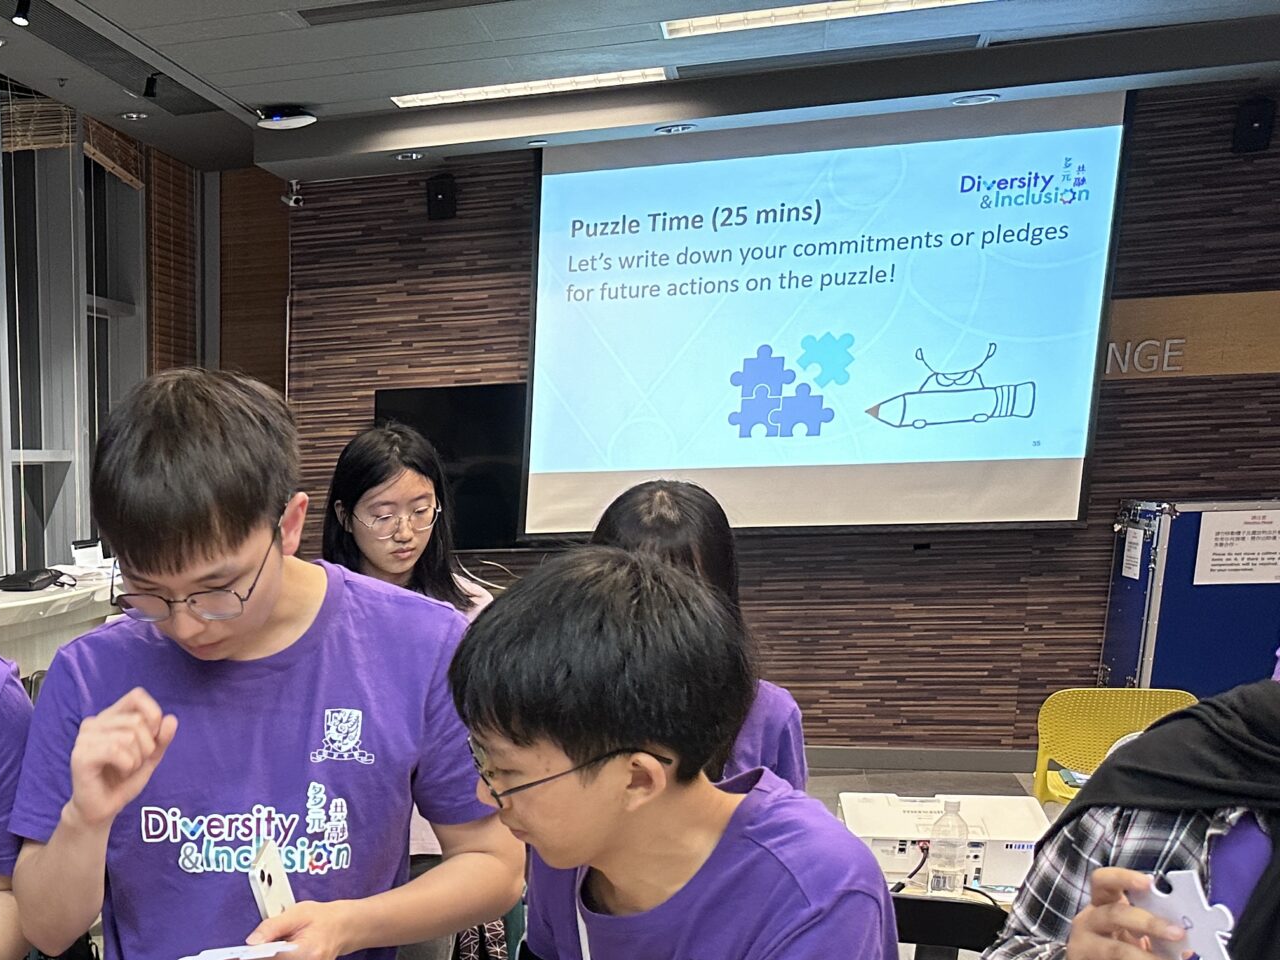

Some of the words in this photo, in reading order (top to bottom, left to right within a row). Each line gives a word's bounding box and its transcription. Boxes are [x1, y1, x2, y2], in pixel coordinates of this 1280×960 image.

[959, 171, 1055, 194] Diversity
[980, 187, 1090, 209] &Inclusion
[570, 214, 641, 238] Puzzle
[647, 211, 704, 232] Time
[711, 206, 749, 232] (25
[755, 198, 822, 225] mins)
[618, 249, 670, 270] write
[676, 246, 733, 267] down
[739, 244, 788, 266] your
[793, 231, 943, 257] commitments
[950, 230, 975, 248] or
[981, 222, 1069, 249] pledges
[566, 284, 594, 303] for
[599, 282, 661, 301] future
[666, 277, 739, 297] actions
[745, 276, 771, 292] on
[778, 270, 813, 290] the
[820, 263, 896, 291] puzzle!
[1105, 339, 1187, 375] NGE
[141, 805, 299, 846] Diversity
